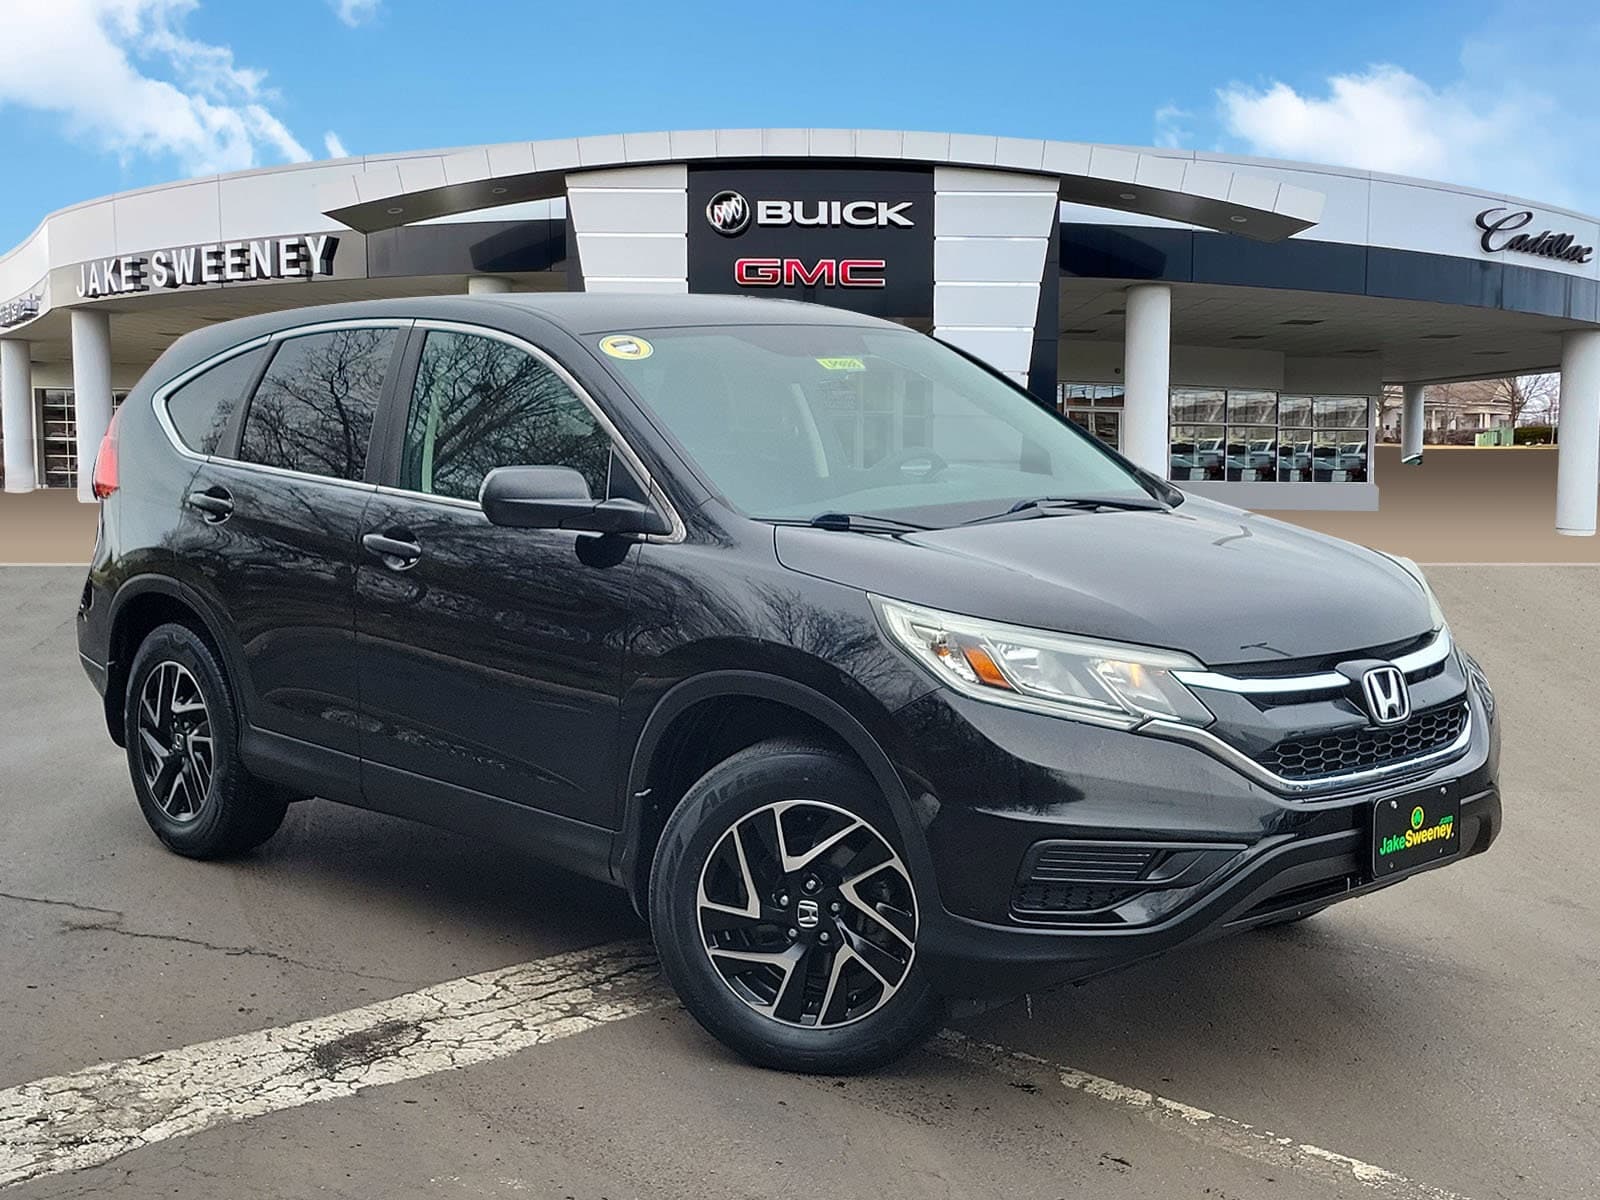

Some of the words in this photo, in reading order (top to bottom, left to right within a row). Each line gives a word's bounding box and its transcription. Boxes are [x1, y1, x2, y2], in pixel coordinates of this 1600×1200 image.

[757, 200, 915, 226] BUICK
[1475, 207, 1593, 263] Cadillac
[76, 256, 142, 298] JAKE
[152, 235, 334, 288] SWEENEY
[735, 258, 886, 287] GMC
